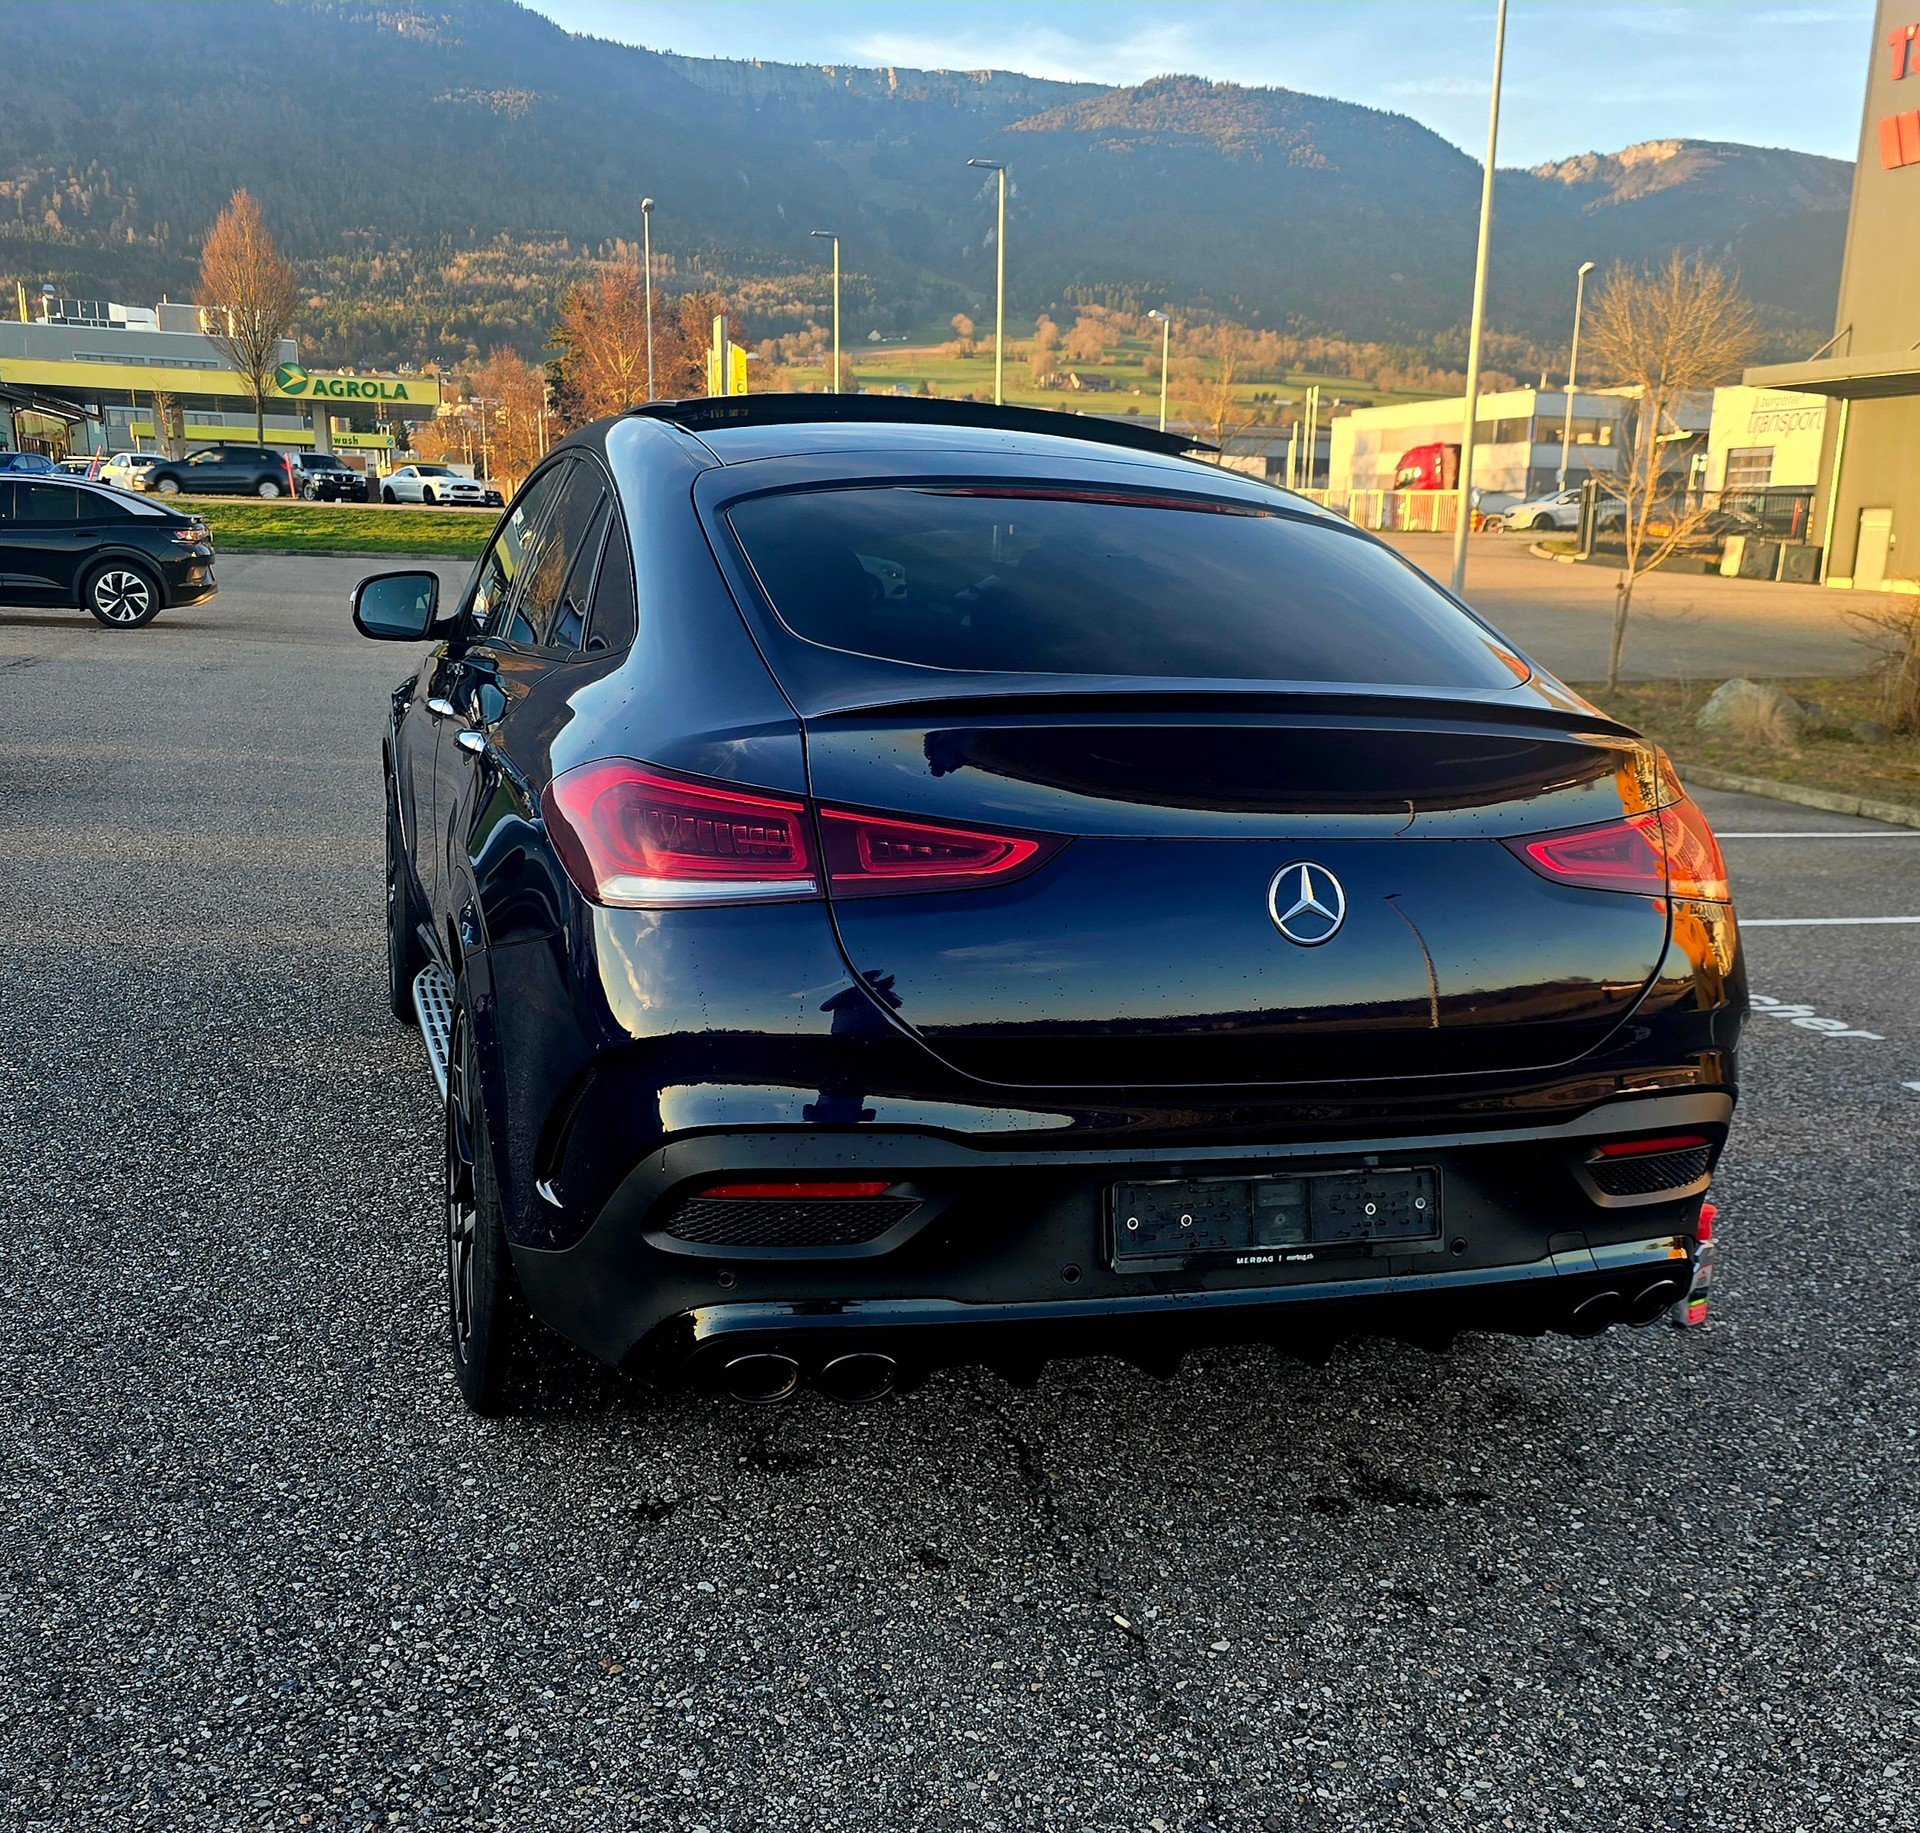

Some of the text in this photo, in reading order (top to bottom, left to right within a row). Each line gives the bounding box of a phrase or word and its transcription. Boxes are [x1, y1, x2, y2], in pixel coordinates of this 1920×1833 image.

[312, 379, 409, 400] AGROLA
[333, 436, 359, 445] wash
[1748, 993, 1886, 1040] cher
